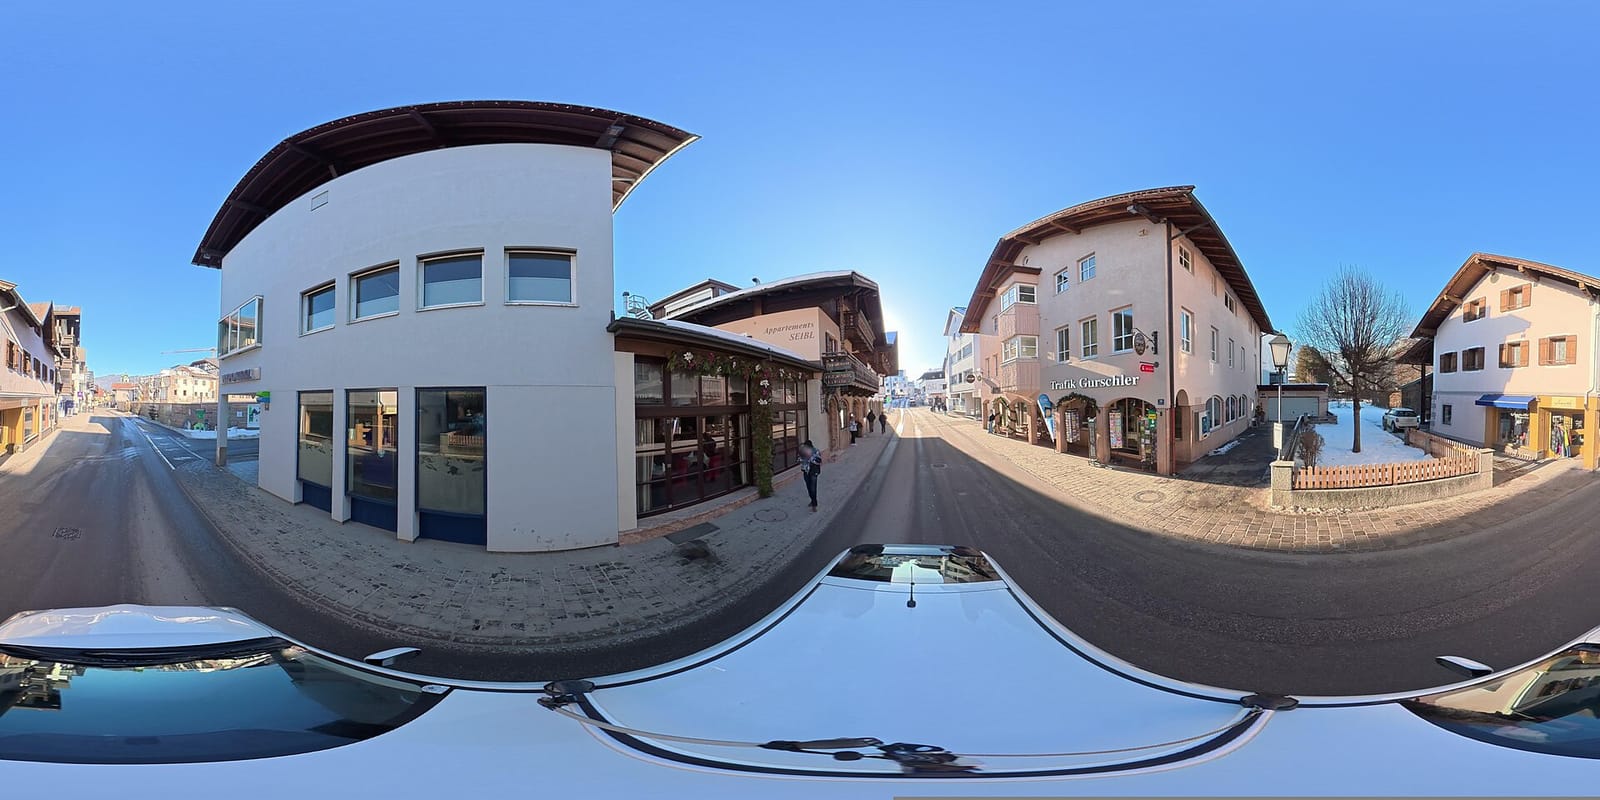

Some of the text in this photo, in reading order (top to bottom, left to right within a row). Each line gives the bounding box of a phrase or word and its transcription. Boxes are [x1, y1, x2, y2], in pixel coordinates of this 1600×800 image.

[763, 322, 814, 335] Appartements
[1050, 375, 1139, 390] Trafik Gurschler
